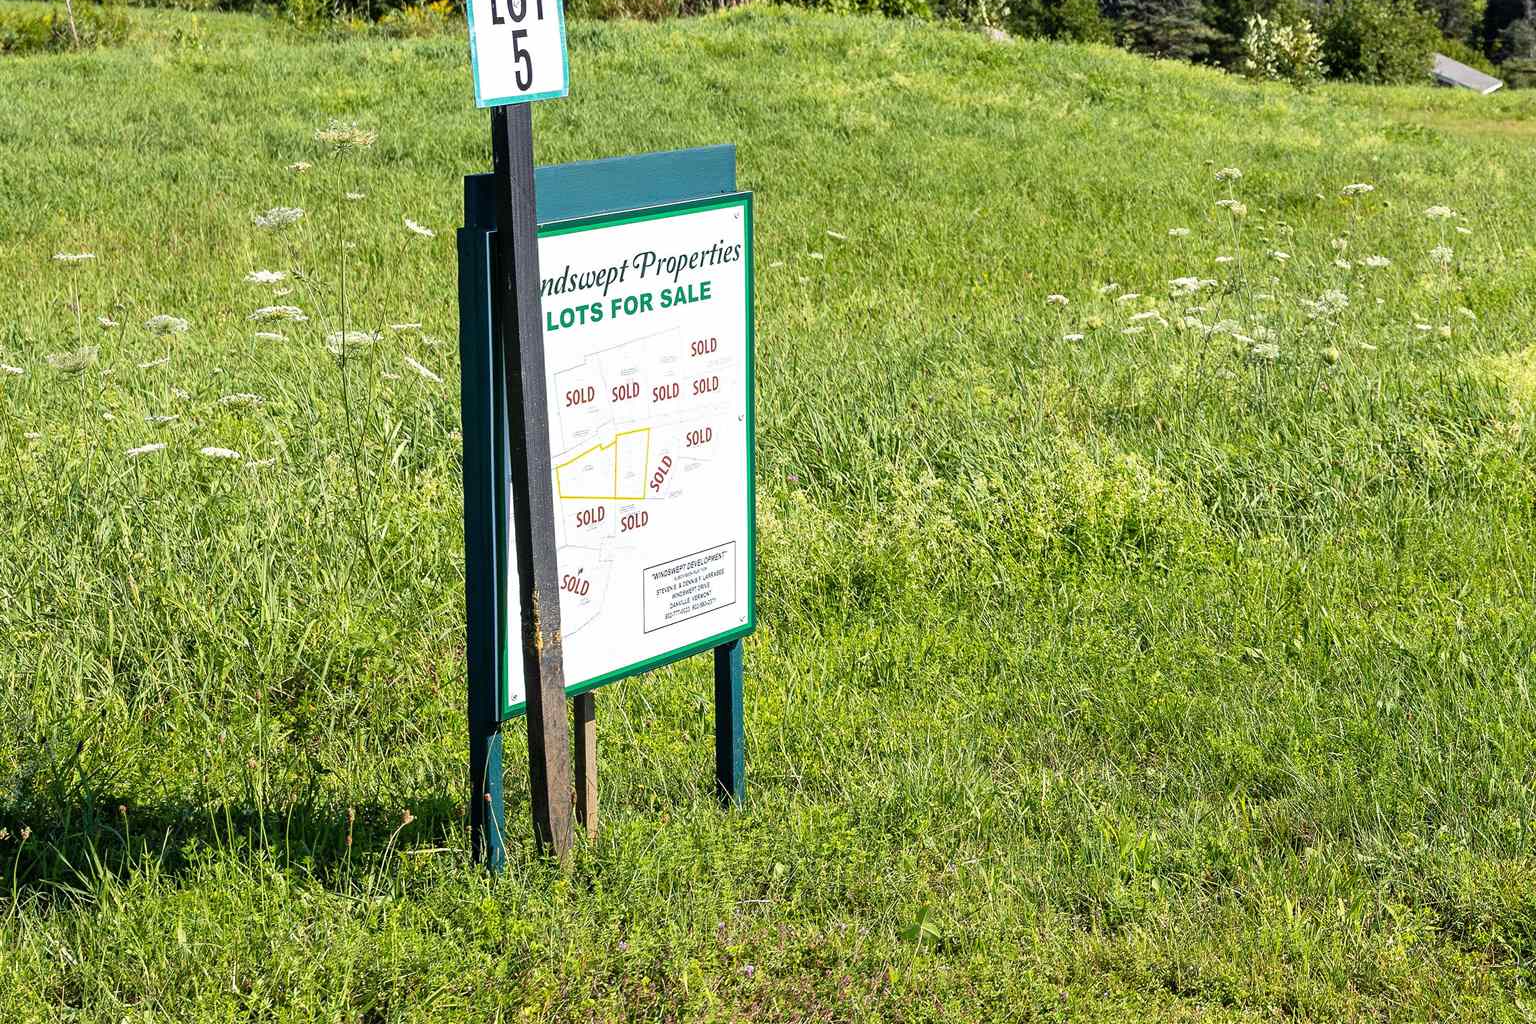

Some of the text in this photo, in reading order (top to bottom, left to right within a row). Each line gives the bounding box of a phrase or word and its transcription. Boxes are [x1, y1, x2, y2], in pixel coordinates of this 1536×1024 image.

[512, 28, 533, 91] 5
[541, 240, 741, 296] ndswept Properties
[546, 281, 712, 331] LOTS FOR SALE
[691, 337, 717, 357] SOLD
[612, 382, 640, 402] SOLD
[652, 382, 680, 403] SOLD
[693, 376, 719, 395] SOLD
[566, 386, 595, 407] SOLD
[686, 427, 712, 447] SOLD
[650, 455, 672, 493] SOLD
[576, 506, 605, 527] SOLD
[621, 511, 648, 532] SOLD
[560, 574, 590, 596] SOLD
